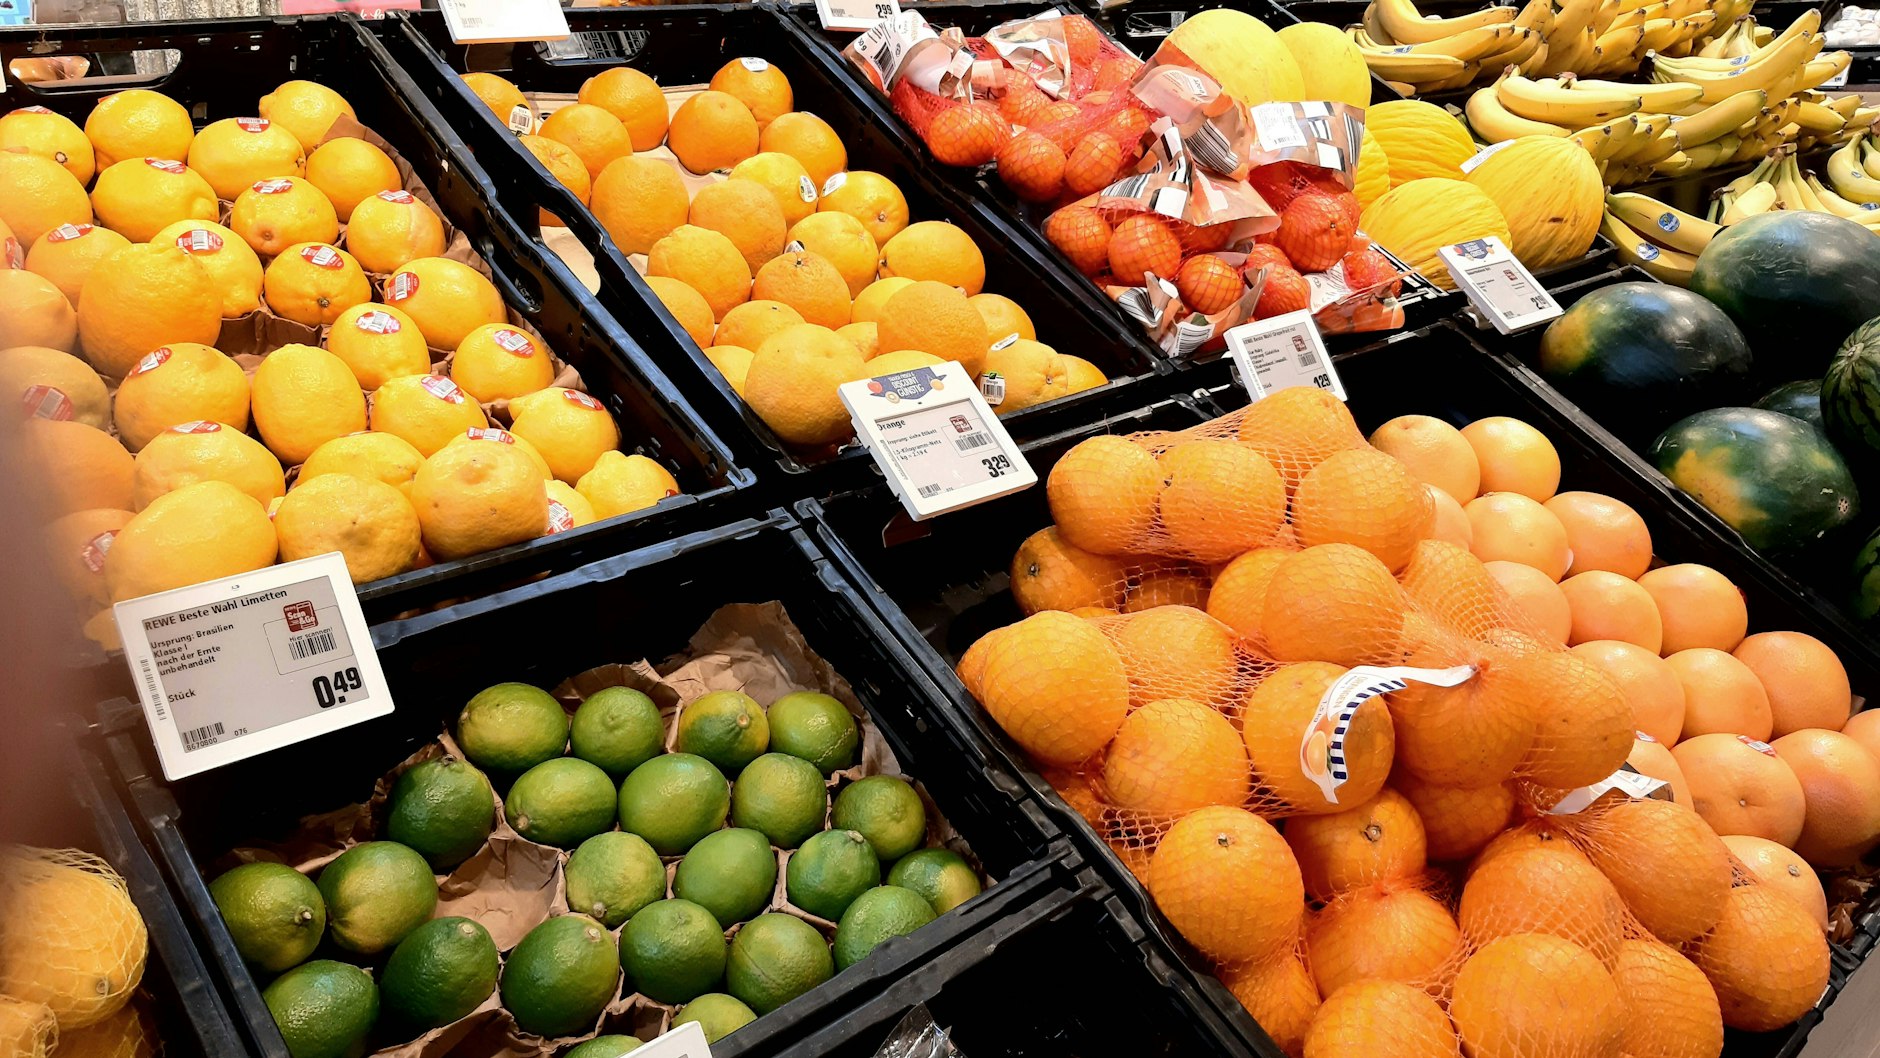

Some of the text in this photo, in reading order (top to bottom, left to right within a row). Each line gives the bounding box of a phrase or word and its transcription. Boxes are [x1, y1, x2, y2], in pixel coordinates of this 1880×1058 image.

[875, 3, 893, 19] 2.99
[981, 454, 1010, 478] 3.29
[145, 589, 288, 631] REWE Beste Wahl Limetten
[287, 611, 306, 620] Scan
[150, 623, 234, 649] Ursprung: Brasilien
[289, 635, 303, 643] Hier
[153, 646, 183, 659] Klasse
[157, 645, 221, 667] nach der Ernte
[160, 655, 216, 676] unbehandelt
[168, 688, 196, 703] Stück
[312, 667, 362, 708] 0.49
[186, 727, 248, 751] 8670800 076
